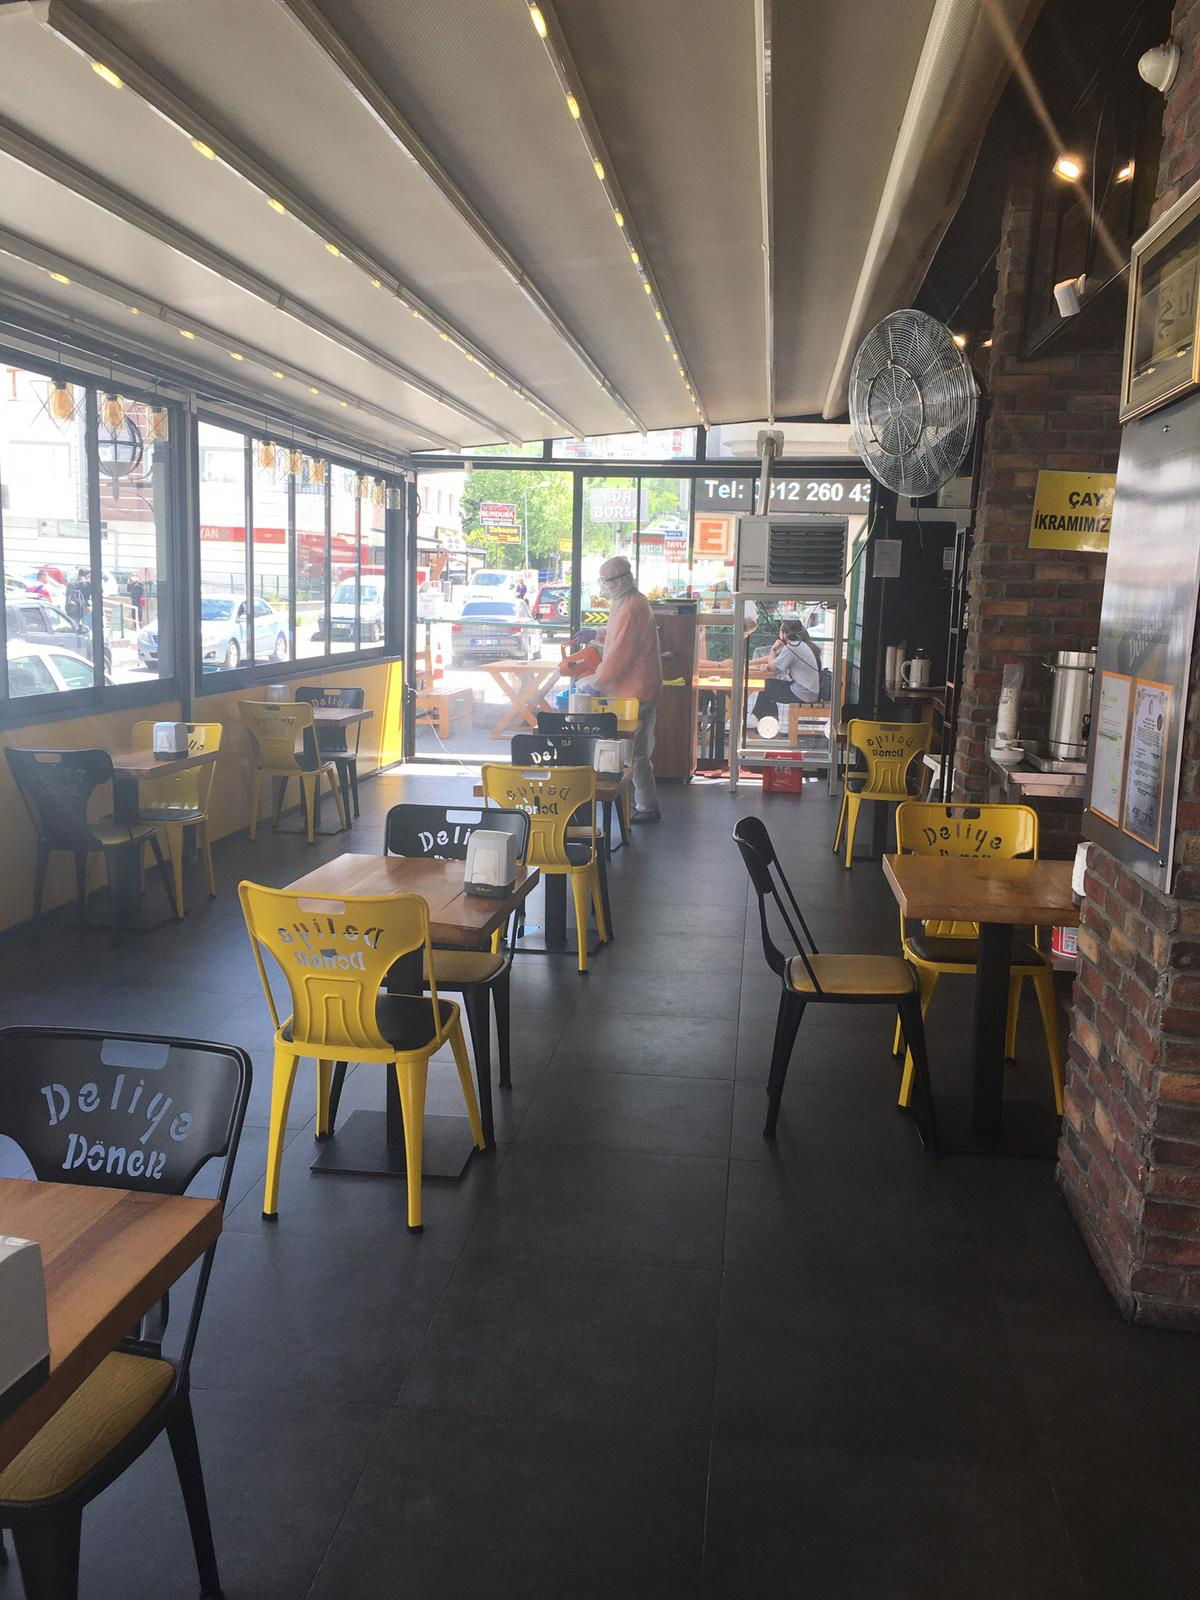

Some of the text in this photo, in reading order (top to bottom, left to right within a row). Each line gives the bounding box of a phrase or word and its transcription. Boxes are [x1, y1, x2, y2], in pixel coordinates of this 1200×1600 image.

[704, 479, 744, 499] Tel:
[806, 481, 844, 502] 260
[1068, 491, 1104, 509] ÇAY
[922, 823, 1003, 853] Deliye
[40, 1073, 193, 1145] Deliye
